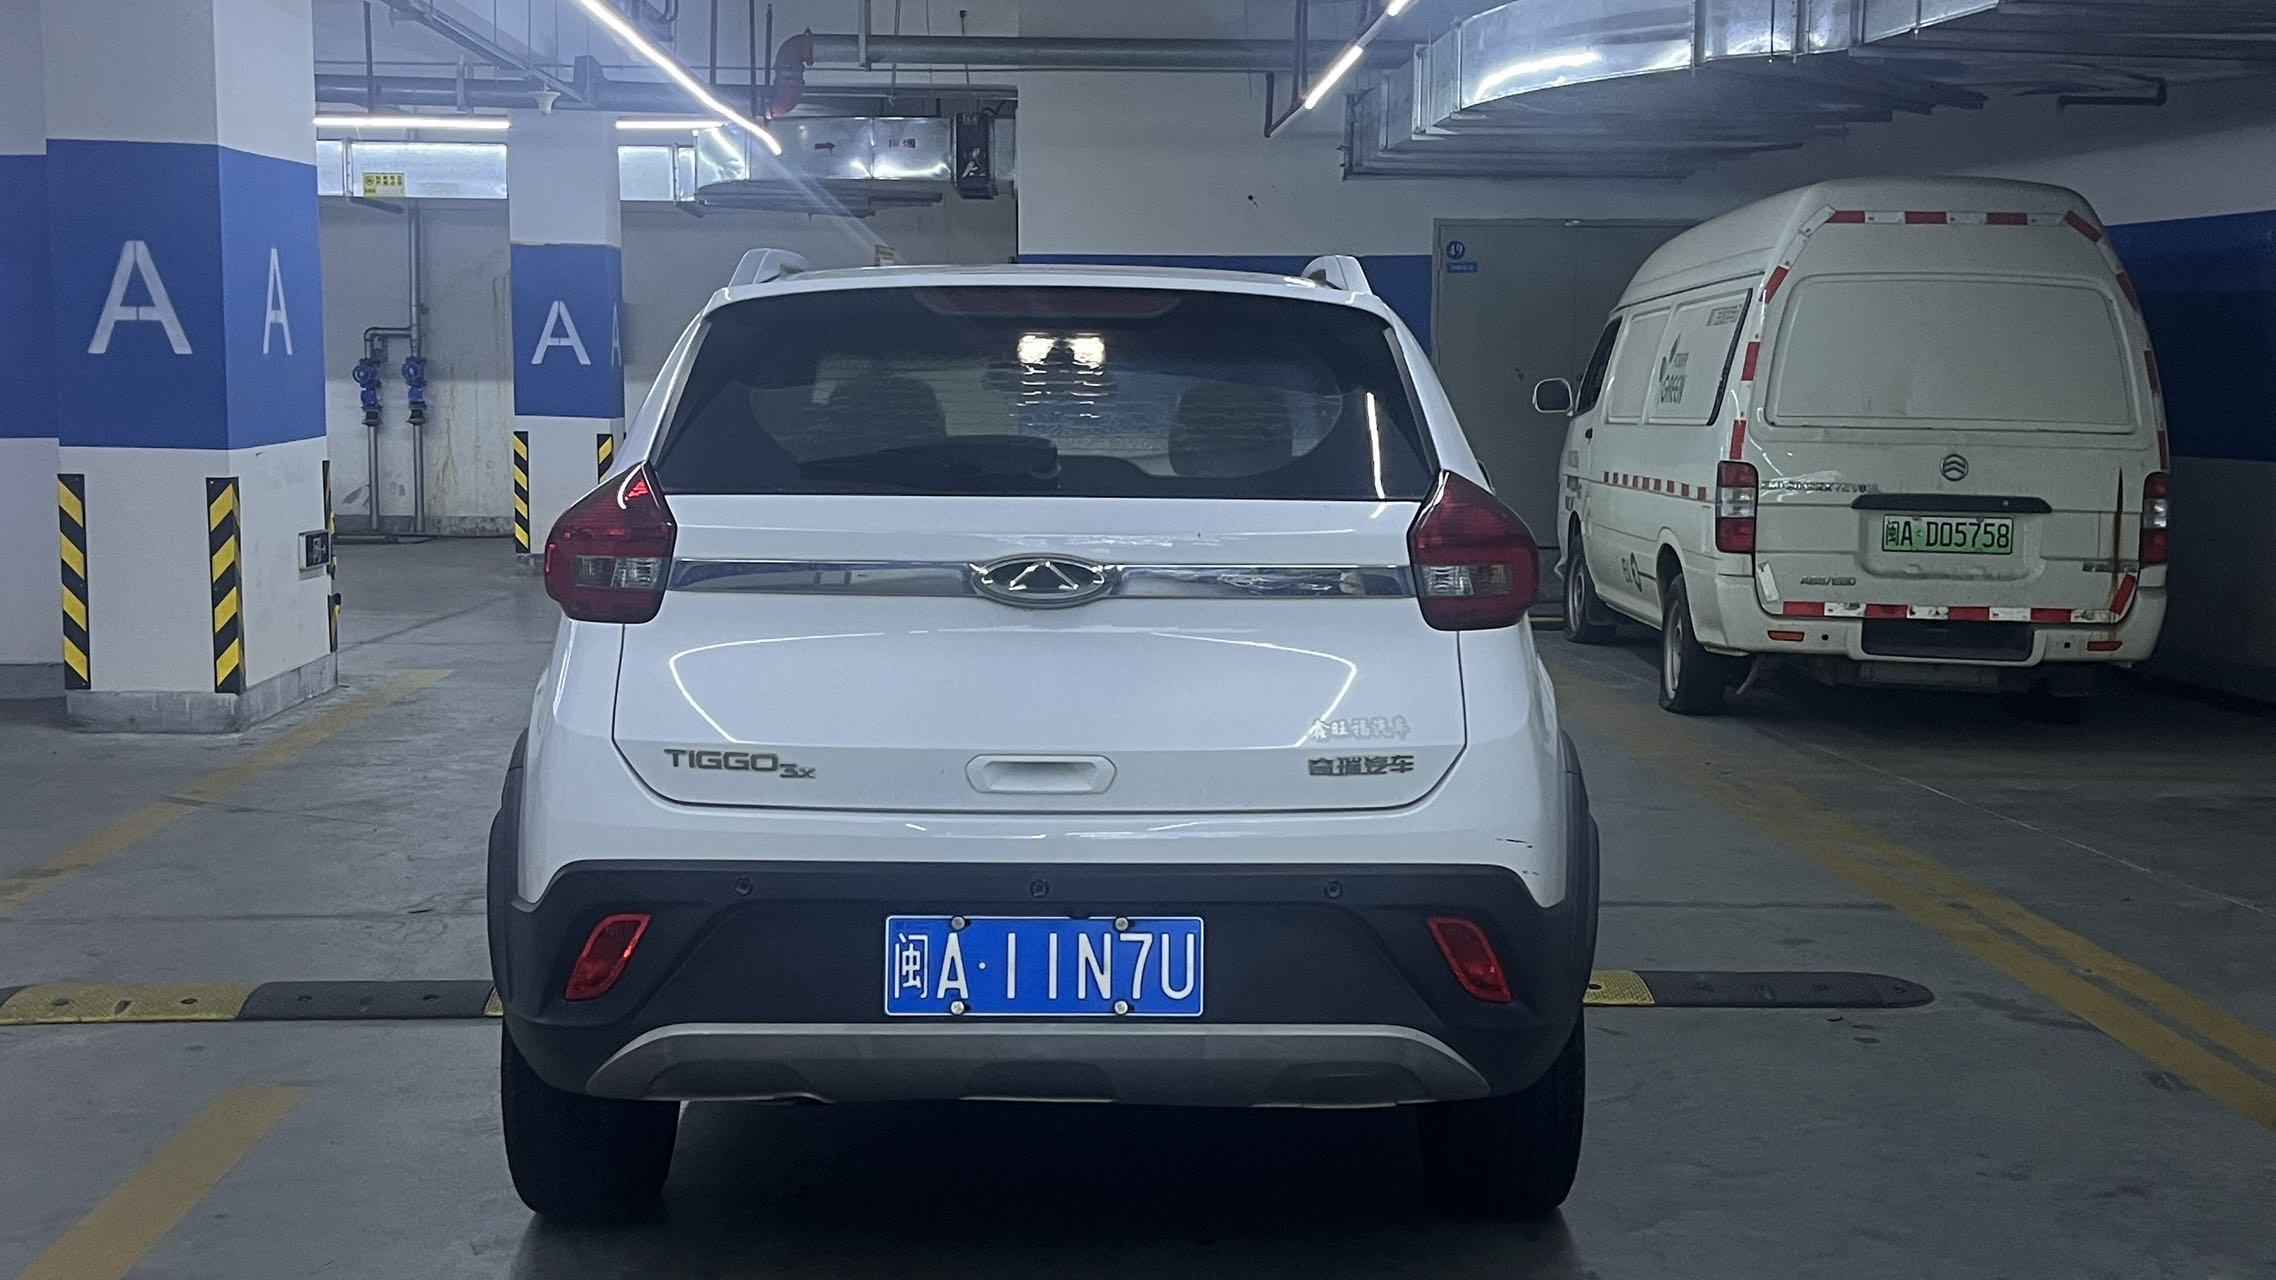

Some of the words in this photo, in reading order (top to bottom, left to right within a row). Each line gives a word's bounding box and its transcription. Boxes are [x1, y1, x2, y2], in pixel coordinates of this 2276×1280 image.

[88, 240, 193, 355] A
[263, 248, 293, 355] A
[531, 301, 591, 365] A
[610, 302, 622, 367] A
[664, 749, 779, 772] TIGGO
[1308, 755, 1414, 776] 奇瑞汽车
